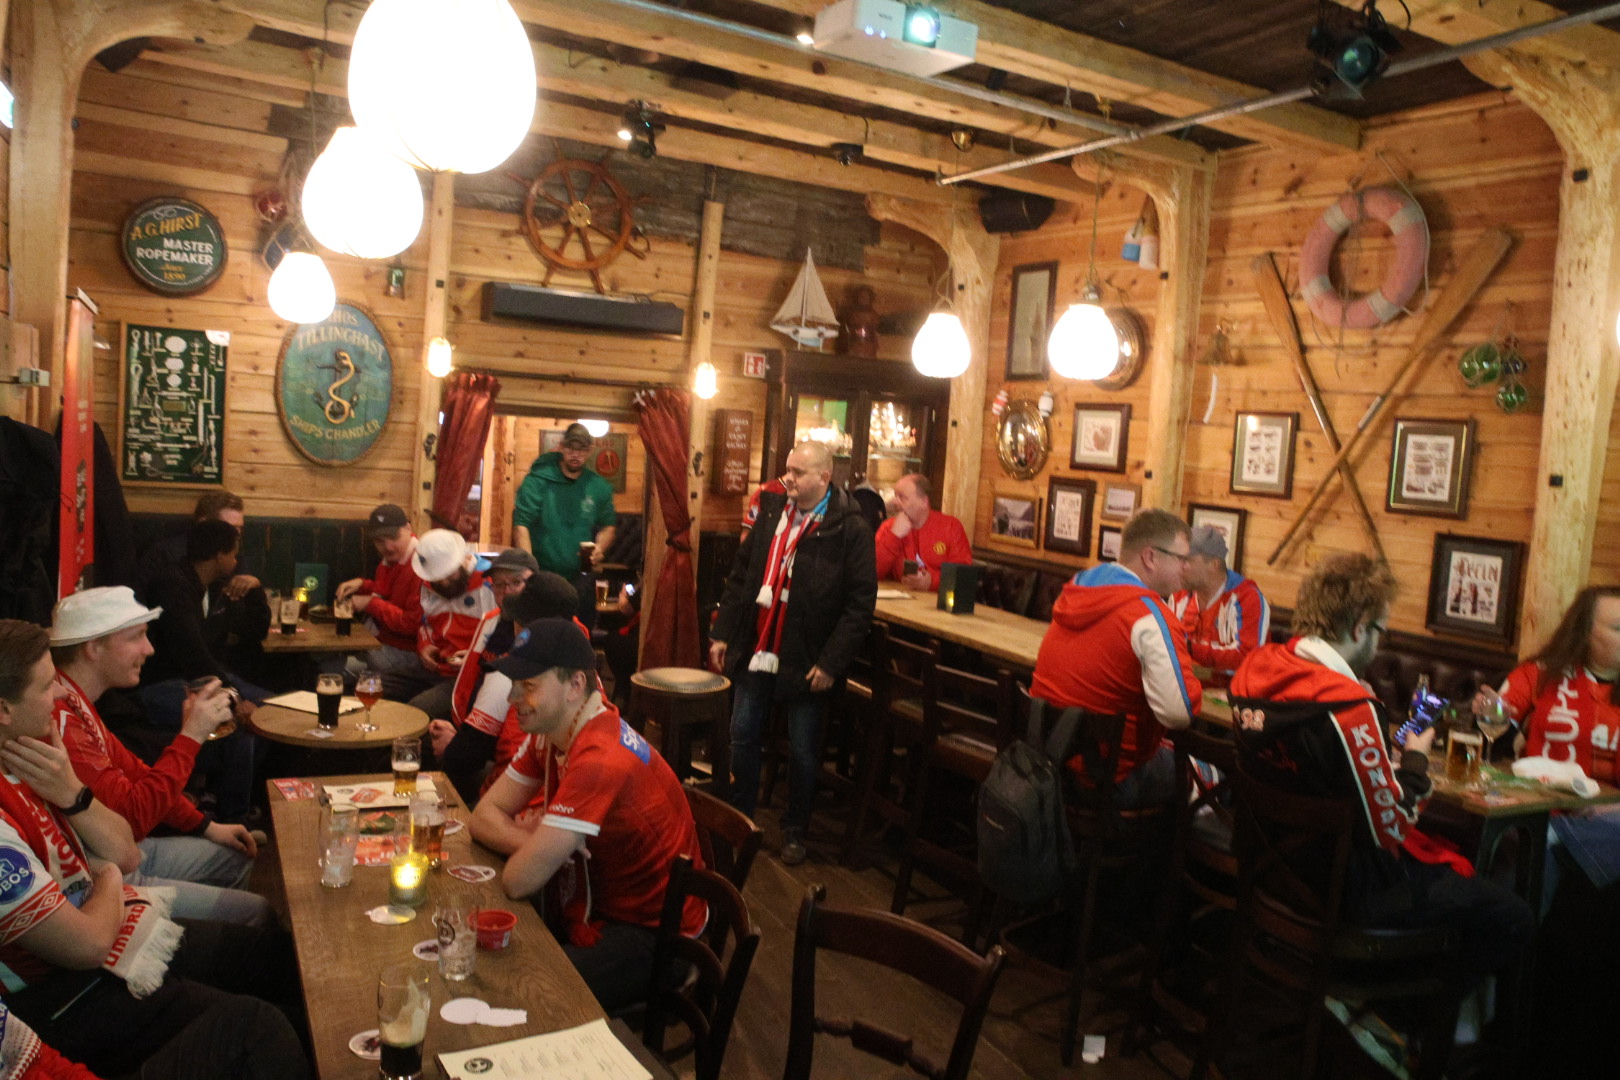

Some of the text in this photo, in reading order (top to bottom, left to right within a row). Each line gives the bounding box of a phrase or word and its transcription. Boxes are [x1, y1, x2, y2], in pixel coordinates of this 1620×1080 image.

[159, 213, 204, 235] HIRST
[136, 246, 214, 266] ROPEMAKER
[162, 237, 214, 254] MASTER
[325, 418, 381, 441] CHANDLER
[0, 866, 30, 897] BOS
[103, 903, 147, 969] UMBRO
